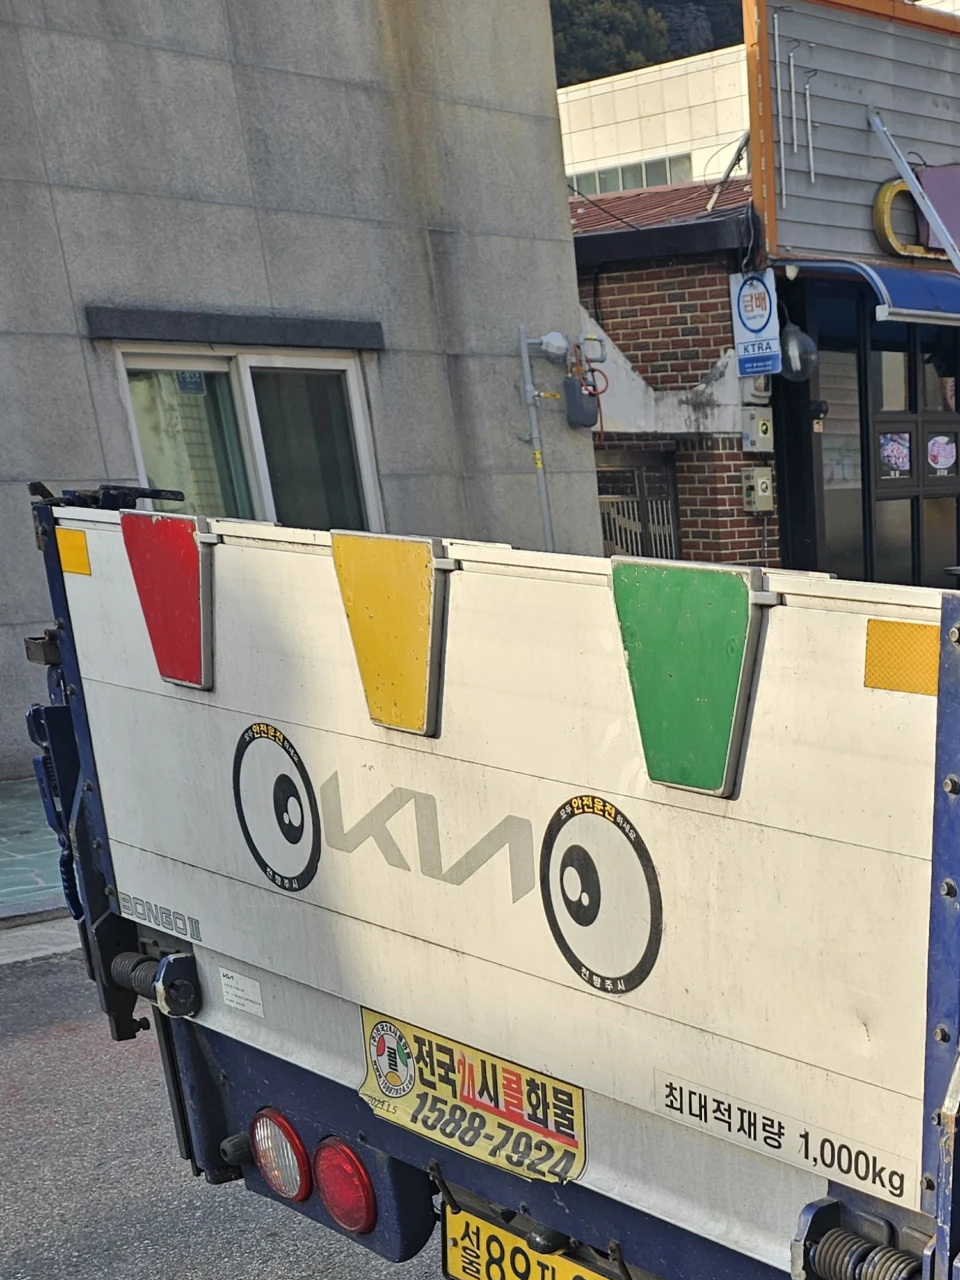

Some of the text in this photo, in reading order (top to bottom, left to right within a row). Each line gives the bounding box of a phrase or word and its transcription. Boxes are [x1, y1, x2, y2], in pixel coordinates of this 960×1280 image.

[742, 291, 767, 313] 담배
[743, 341, 772, 354] KTRA
[252, 723, 284, 746] 안전운전
[319, 769, 536, 904] KIA
[559, 796, 637, 842] 모두 안전운전 하세요
[119, 891, 188, 936] BONGO
[409, 1091, 577, 1183] 1588-7924
[664, 1082, 905, 1198] 최대적재량 1,000kg
[460, 1220, 481, 1280] 서울
